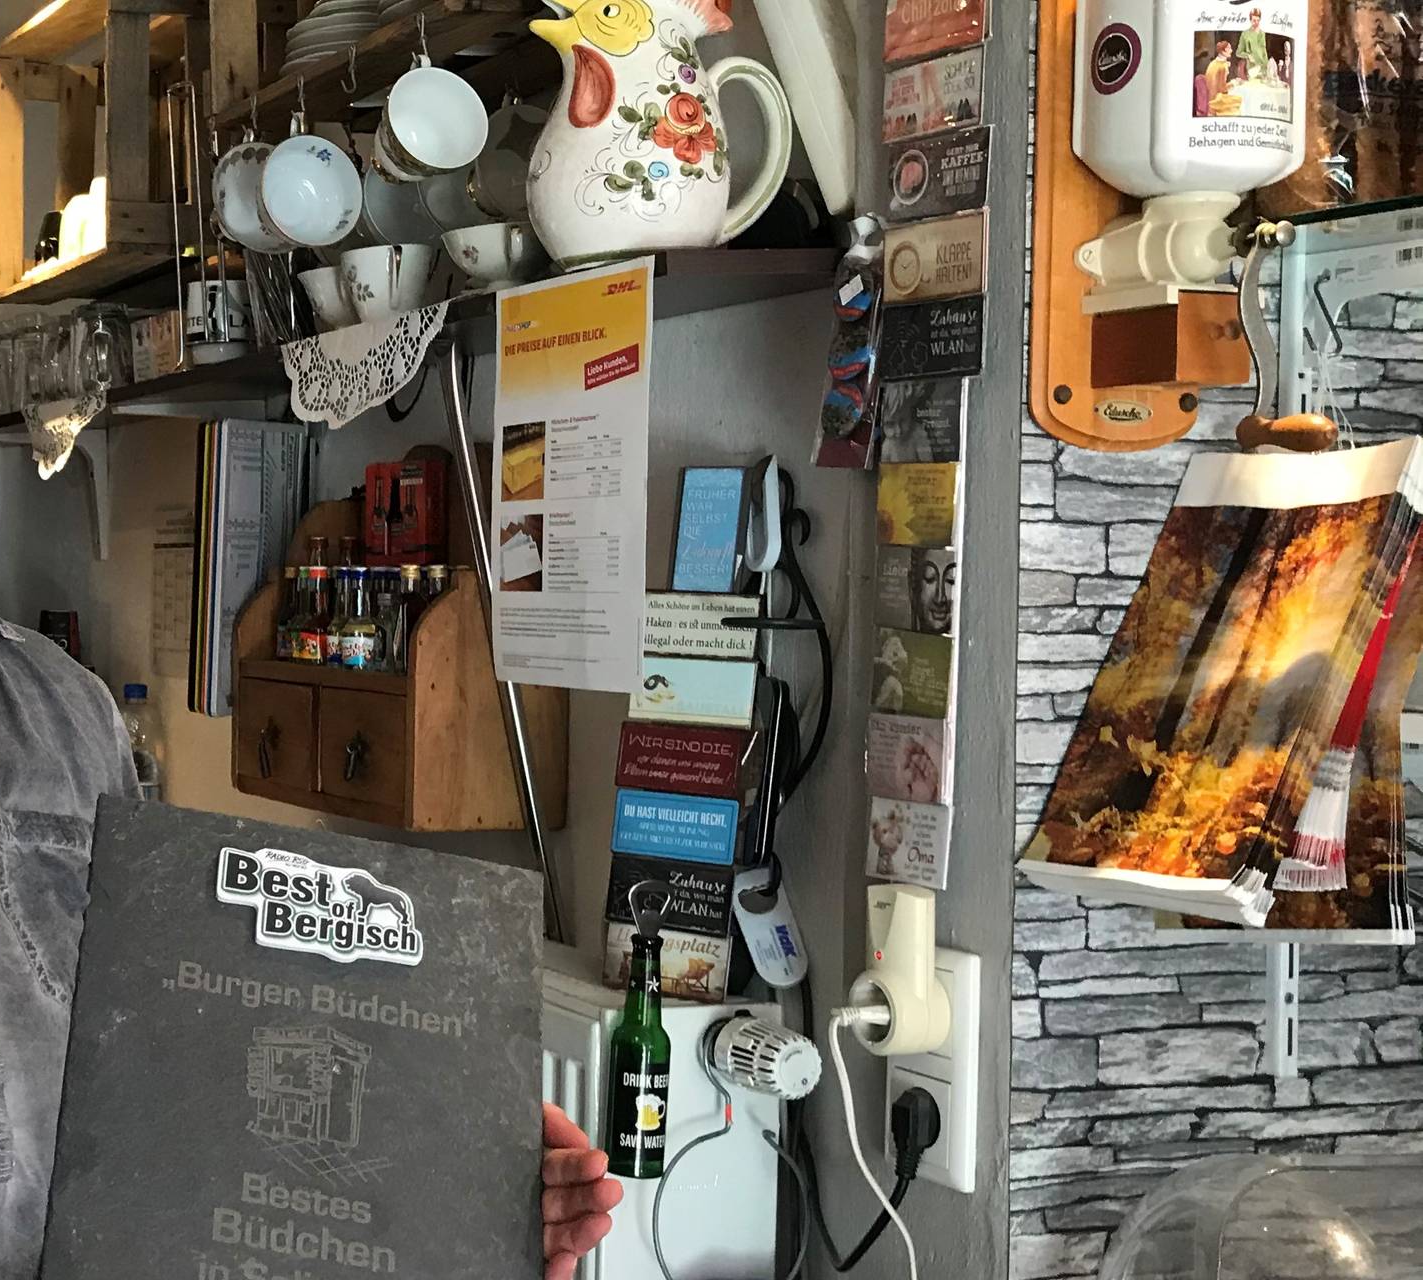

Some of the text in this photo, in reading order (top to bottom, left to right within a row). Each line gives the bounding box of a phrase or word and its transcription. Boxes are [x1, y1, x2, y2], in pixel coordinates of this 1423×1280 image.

[1202, 122, 1239, 134] schafft
[1188, 136, 1236, 151] Behagen
[1238, 136, 1255, 148] und
[941, 151, 984, 170] KAFFEE
[936, 241, 972, 265] KLAPPE
[607, 280, 636, 296] DHL
[505, 327, 608, 357] DIE PREISE AUF EINEN BLICK.
[930, 338, 965, 356] WLAN
[587, 362, 603, 377] Liebe
[646, 617, 673, 628] Haken
[679, 620, 688, 629] es
[689, 618, 699, 629] ist
[645, 634, 671, 648] illegal
[673, 636, 694, 647] oder
[695, 637, 724, 649] macht
[726, 638, 746, 650] dick
[629, 734, 734, 758] WIR SIND DIE,
[624, 804, 636, 818] DU
[637, 805, 657, 819] HAST
[658, 807, 699, 824] VIELLEICHT
[265, 850, 291, 862] RADIO
[908, 846, 934, 864] Oma
[224, 851, 332, 907] Best
[669, 870, 726, 895] Zuhause
[707, 895, 725, 903] man
[332, 902, 354, 919] of
[709, 908, 723, 919] hat
[265, 900, 416, 951] Bergisch
[623, 1072, 653, 1089] DRINK
[619, 1133, 640, 1148] SAV
[241, 1171, 372, 1224] Bestes
[212, 1206, 397, 1273] Büdchen
